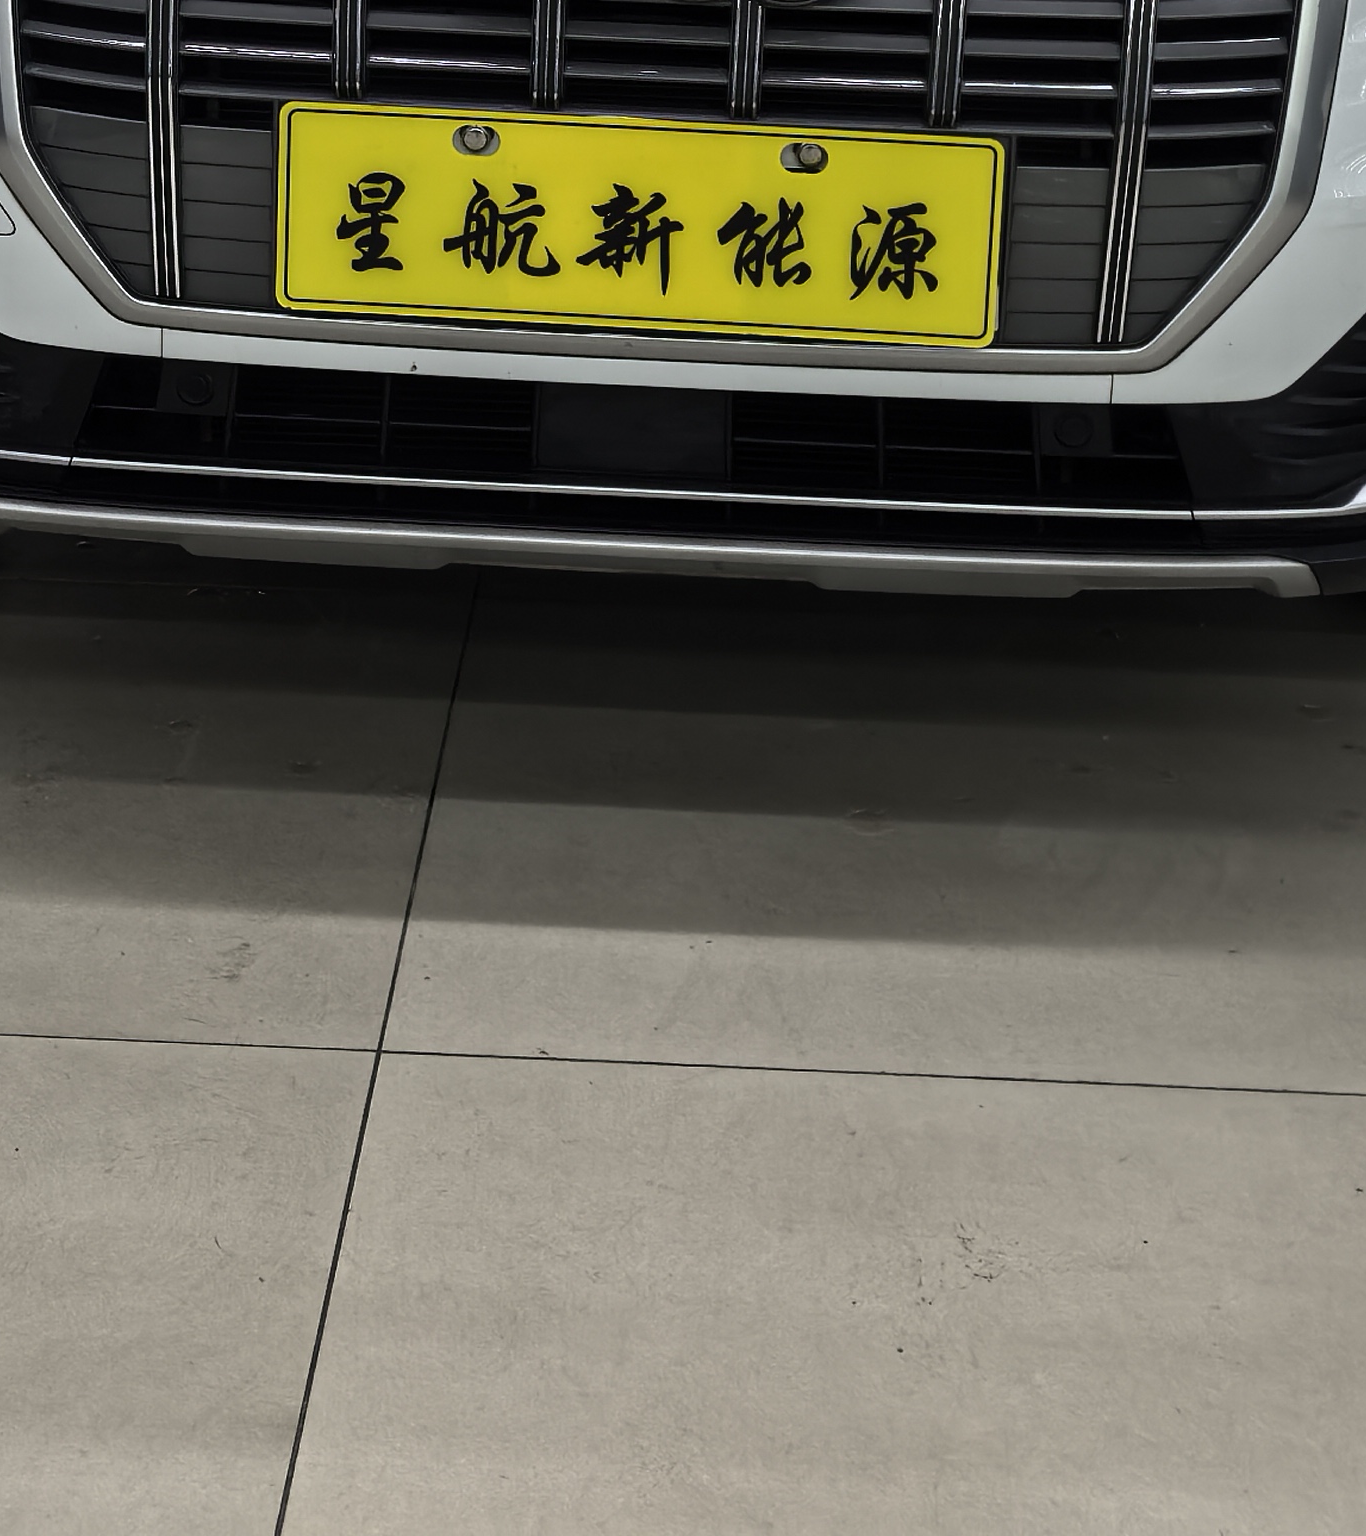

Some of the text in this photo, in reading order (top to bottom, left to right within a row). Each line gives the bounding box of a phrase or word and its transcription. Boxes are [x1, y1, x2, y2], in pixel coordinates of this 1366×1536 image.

[335, 170, 939, 302] 星航新能源
